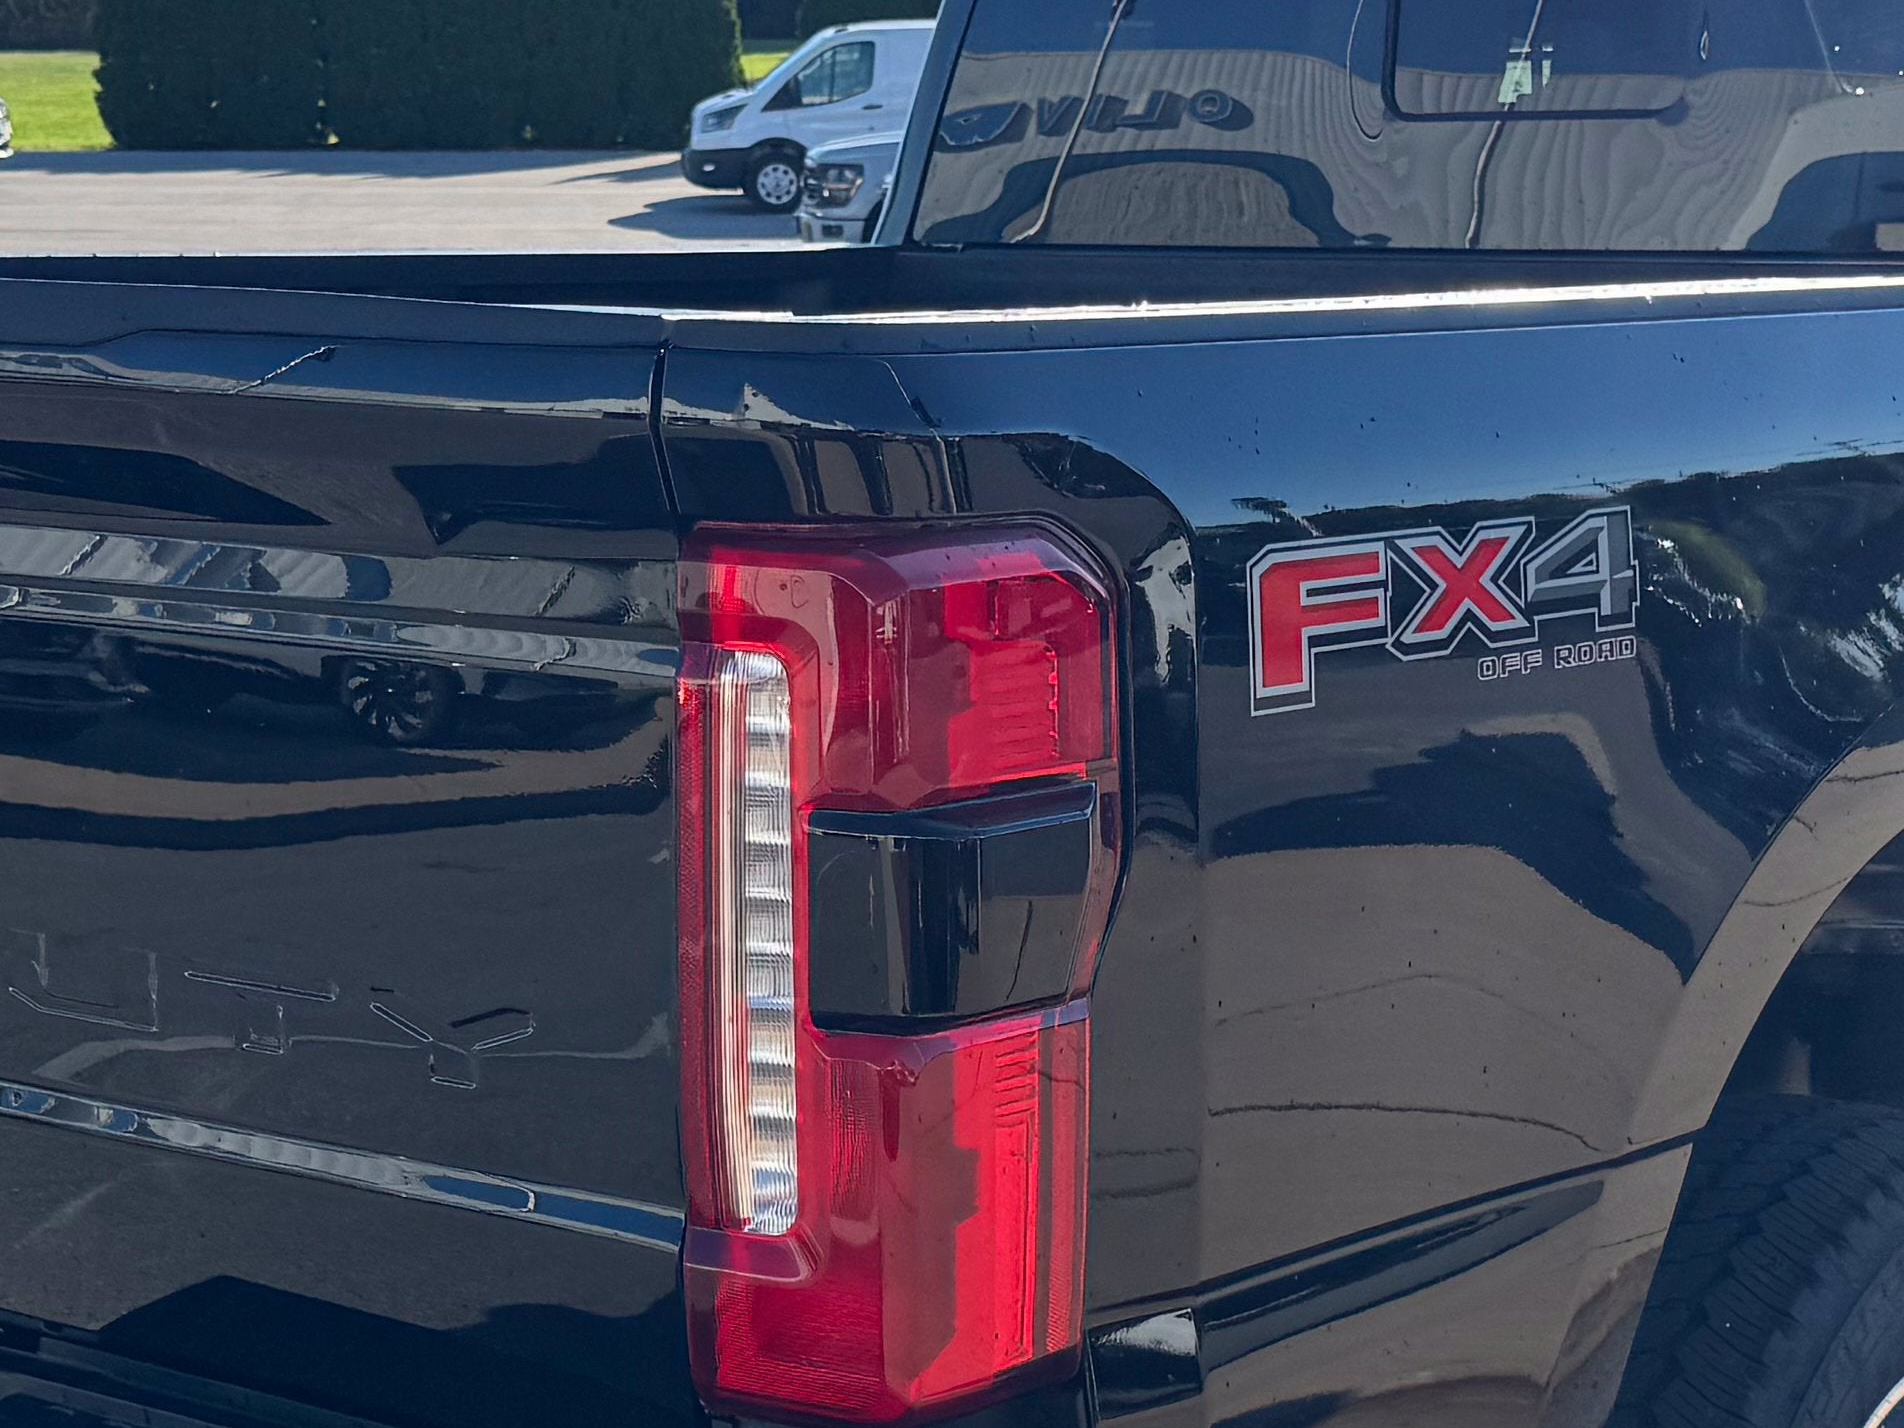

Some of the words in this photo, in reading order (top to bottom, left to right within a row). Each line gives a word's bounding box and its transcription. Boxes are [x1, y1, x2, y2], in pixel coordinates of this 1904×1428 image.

[1246, 505, 1641, 717] FX4
[1477, 649, 1544, 681] OFF
[1554, 635, 1637, 670] ROAD
